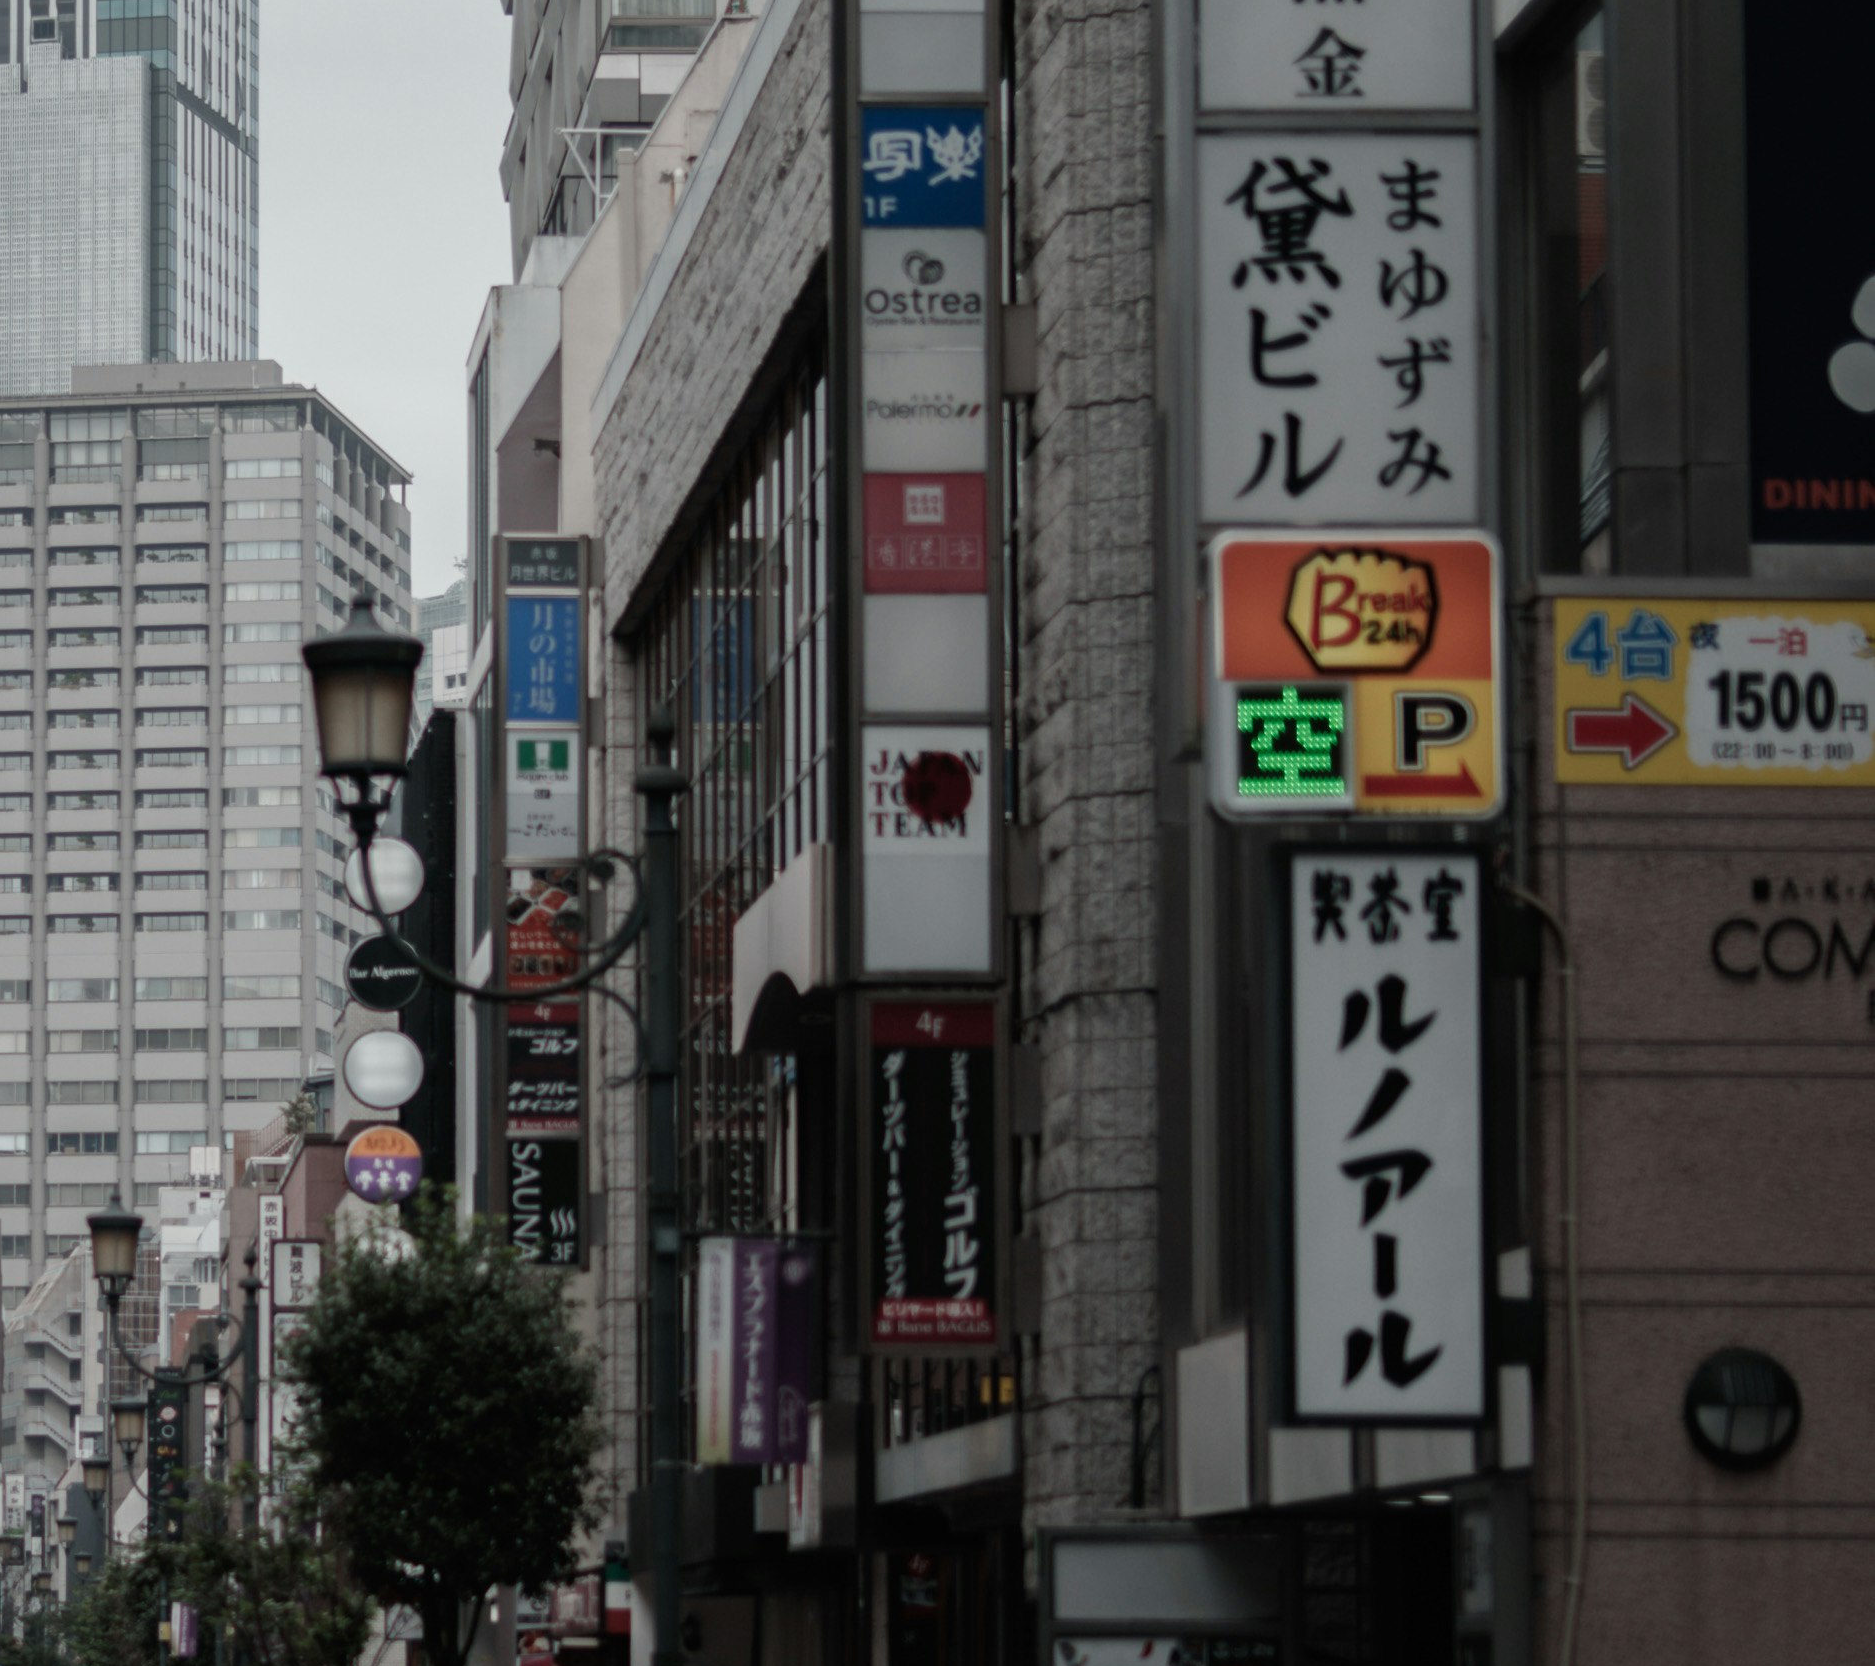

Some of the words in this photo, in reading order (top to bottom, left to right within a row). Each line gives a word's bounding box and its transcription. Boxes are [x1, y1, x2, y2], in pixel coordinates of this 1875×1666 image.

[865, 197, 897, 218] 1F
[865, 289, 981, 315] Ostrea
[1226, 157, 1352, 499] 黛ビル
[1376, 159, 1452, 496] まゆずみ
[510, 564, 575, 582] 月世界ビル
[1364, 619, 1422, 645] 24h
[1748, 628, 1807, 656] 一泊
[1565, 609, 1679, 683] 4台
[1238, 686, 1344, 797] 空
[1395, 692, 1476, 771] P
[870, 812, 968, 838] TEAM
[1312, 869, 1464, 944] 喫茶室
[349, 968, 367, 979] Bar
[530, 1037, 578, 1054] ゴルフ
[508, 1081, 578, 1096] ダーツバー
[1339, 974, 1444, 1389] ルノアール
[512, 1142, 543, 1262] SAUNA
[551, 1241, 574, 1262] 3F
[943, 1184, 980, 1301] ゴルフ
[937, 1318, 990, 1333] BAGUS
